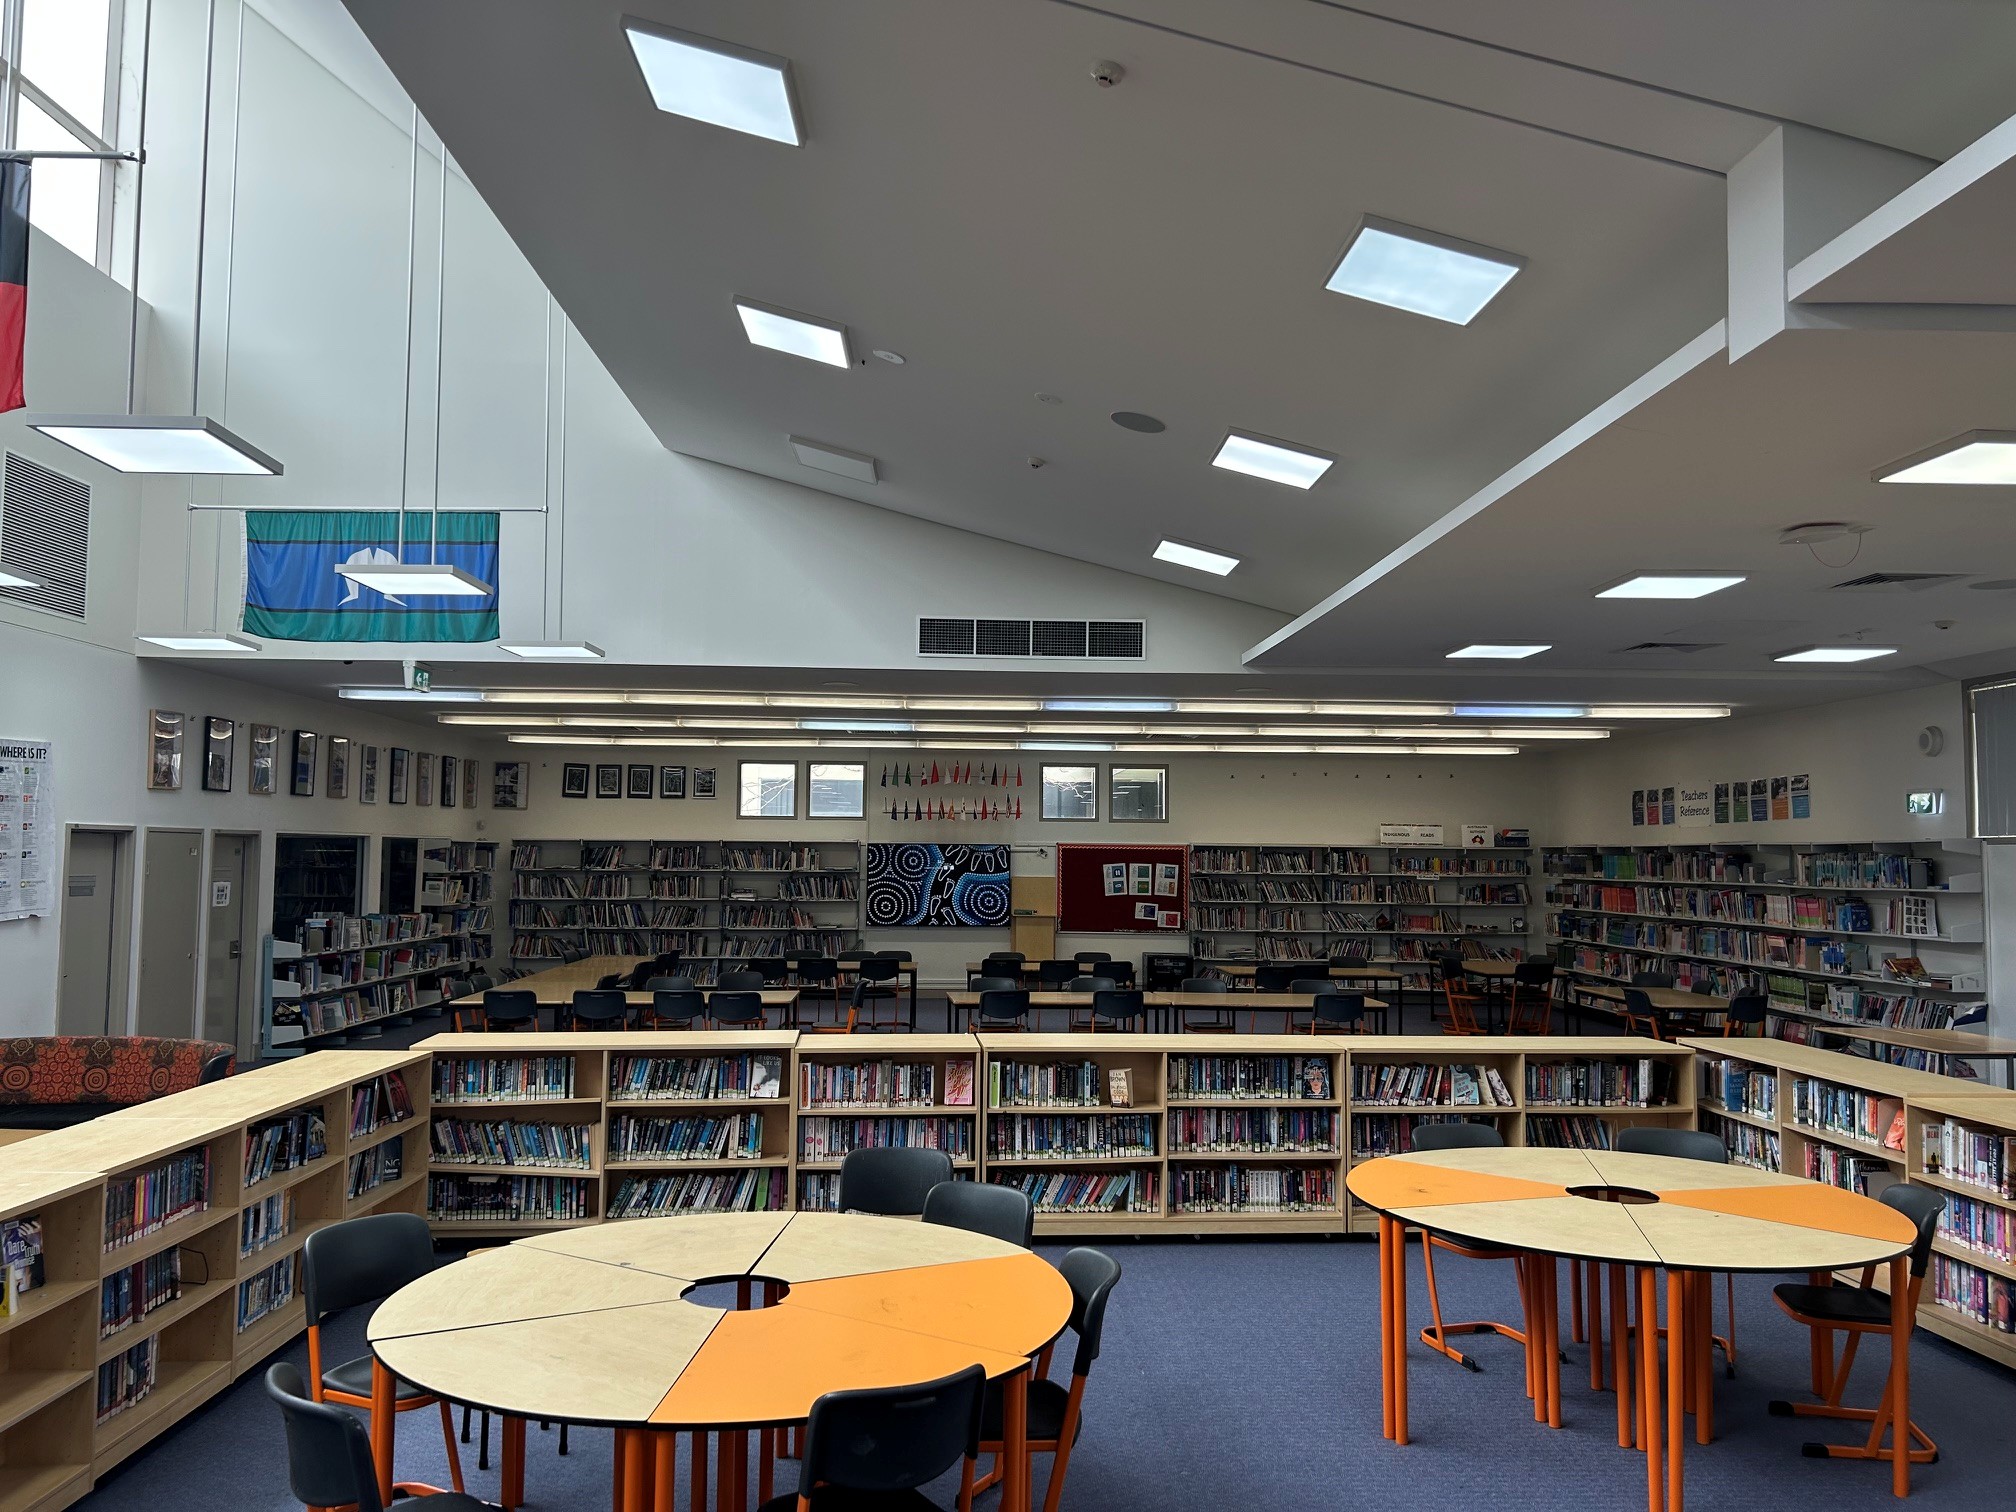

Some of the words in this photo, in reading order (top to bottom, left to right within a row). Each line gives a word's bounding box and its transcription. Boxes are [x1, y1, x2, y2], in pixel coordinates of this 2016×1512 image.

[0, 746, 26, 758] WHERE
[28, 748, 34, 759] IS
[36, 748, 47, 760] IT?
[1681, 790, 1708, 801] Teachers
[1680, 805, 1710, 817] Reference
[8, 1240, 25, 1256] Dare
